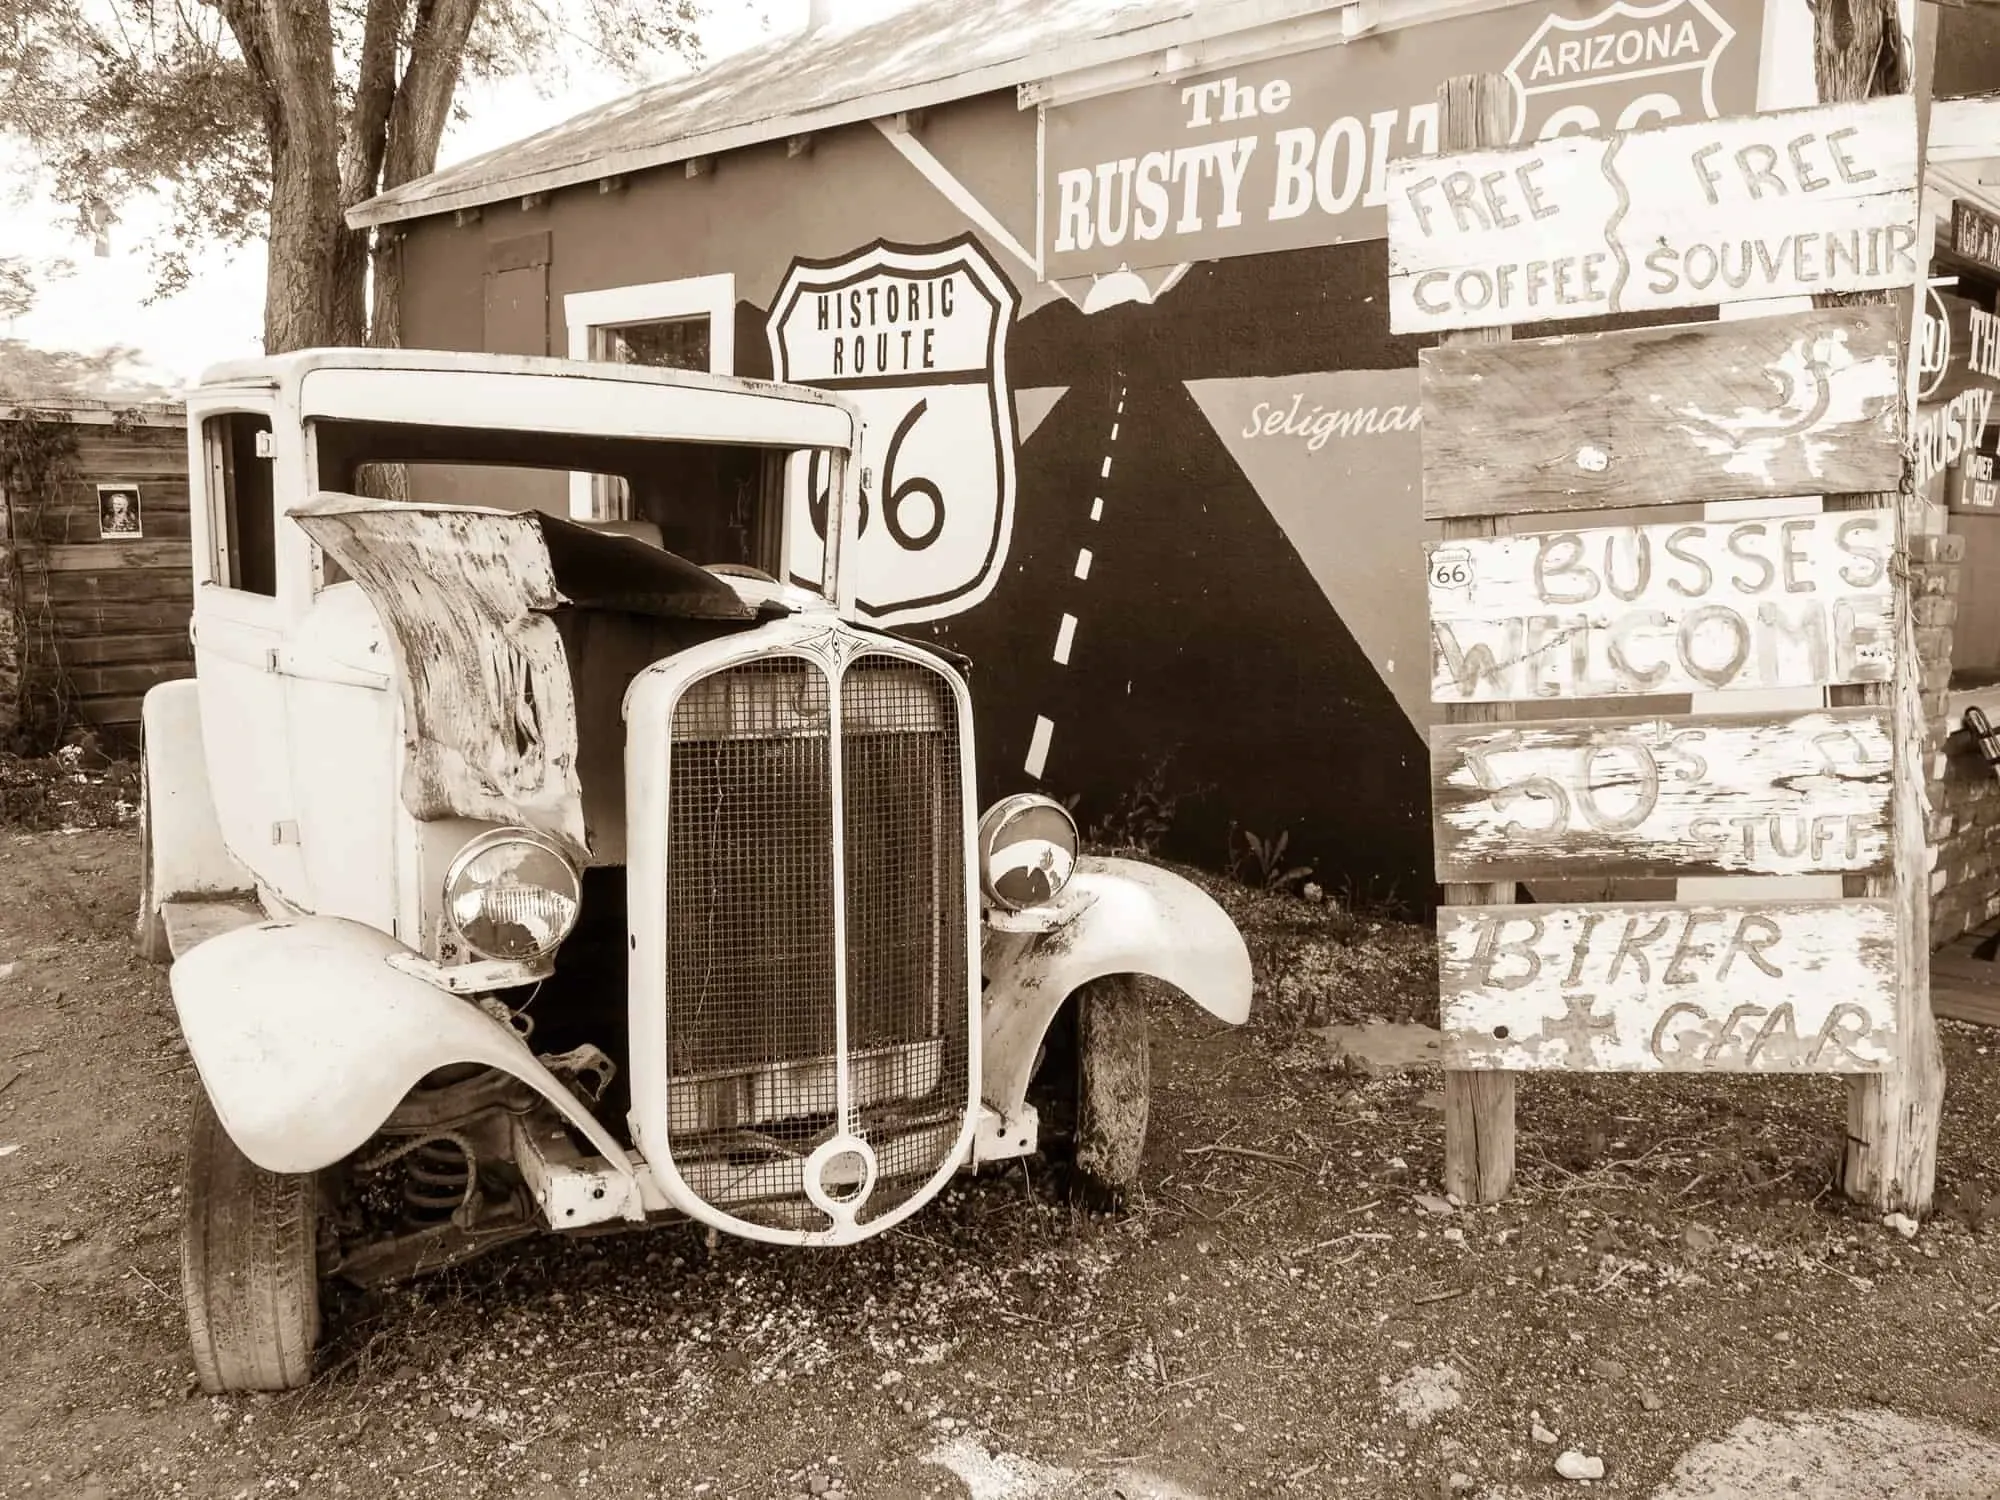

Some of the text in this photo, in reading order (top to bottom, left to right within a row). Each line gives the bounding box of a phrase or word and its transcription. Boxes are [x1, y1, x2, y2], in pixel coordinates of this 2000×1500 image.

[1530, 20, 1700, 80] ARIZONA
[1182, 77, 1292, 129] The
[1054, 135, 1258, 253] RUSTY
[1405, 158, 1561, 238] FREE
[1691, 127, 1877, 205] FREE
[1412, 251, 1607, 315] COFFEE
[1646, 223, 1917, 294] SOUVENIR
[816, 277, 955, 331] HISTORIC
[833, 328, 936, 374] ROUTE
[1967, 306, 2000, 380] TH
[1914, 387, 1993, 490] RUSTY
[1437, 564, 1465, 583] 66
[1534, 518, 1883, 605] BUSSES
[1688, 814, 1882, 862] STUFF
[1472, 912, 1784, 991] BIKER
